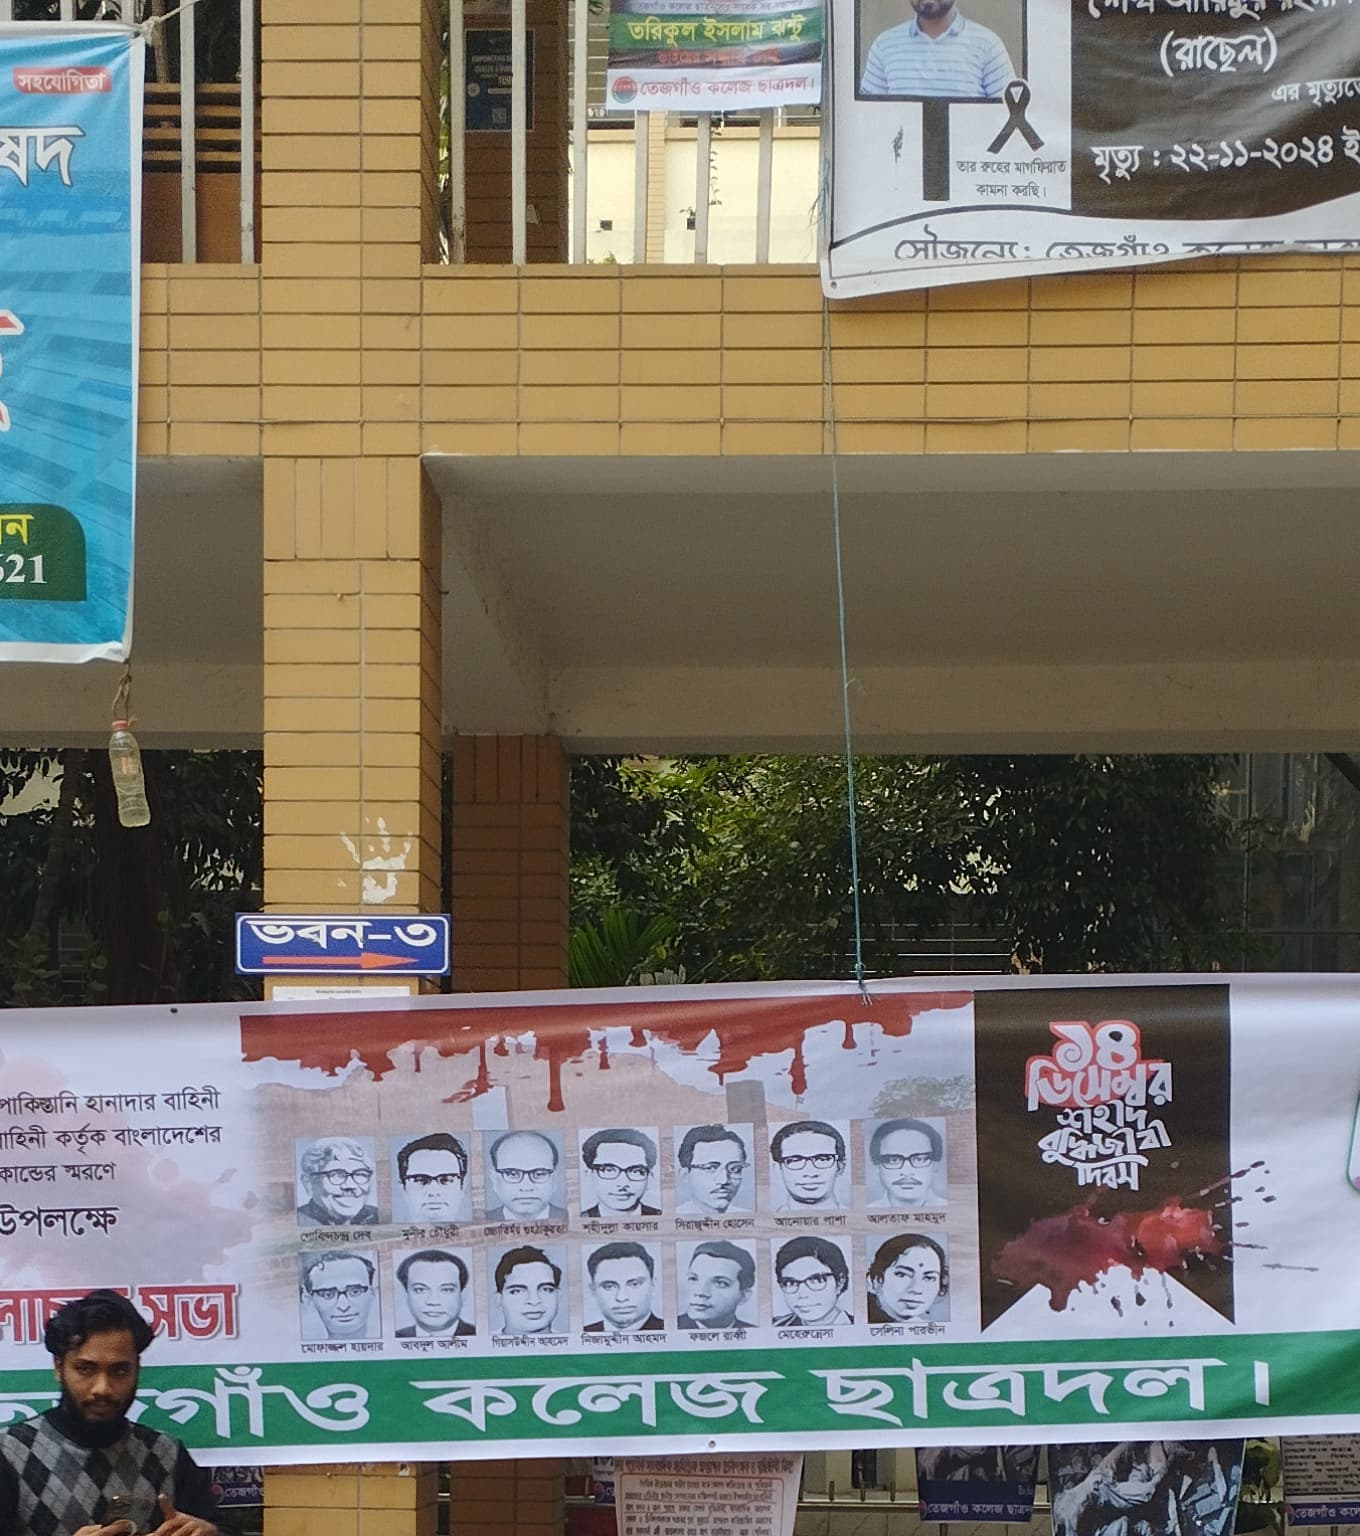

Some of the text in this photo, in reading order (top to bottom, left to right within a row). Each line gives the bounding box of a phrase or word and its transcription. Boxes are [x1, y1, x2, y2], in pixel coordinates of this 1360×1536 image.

[627, 13, 807, 47] তরিকুল ইসলাম ঝন্টু
[19, 71, 106, 93] সহযোগিতা
[708, 79, 754, 95] কলেজ
[1272, 81, 1301, 103] এর
[1090, 145, 1143, 184] মৃত্যু
[1170, 133, 1334, 171] ২২-১১-২০২৪
[246, 921, 437, 949] ভবন-৩
[1053, 1023, 1137, 1072] ১৪
[84, 1093, 156, 1113] হানাদার
[161, 1086, 220, 1110] বাহিনী
[1027, 1058, 1173, 1112] ডিসেম্বর
[1057, 1100, 1148, 1134] শহীদ
[55, 1124, 106, 1156] কর্তৃক
[115, 1124, 221, 1147] বাংলাদেশের
[1037, 1119, 1172, 1166] বুদ্ধিজীবী
[64, 1163, 115, 1181] স্মরণে
[1074, 1154, 1149, 1191] দিবস
[139, 1283, 240, 1341] সভা
[412, 1372, 785, 1433] কলেজ
